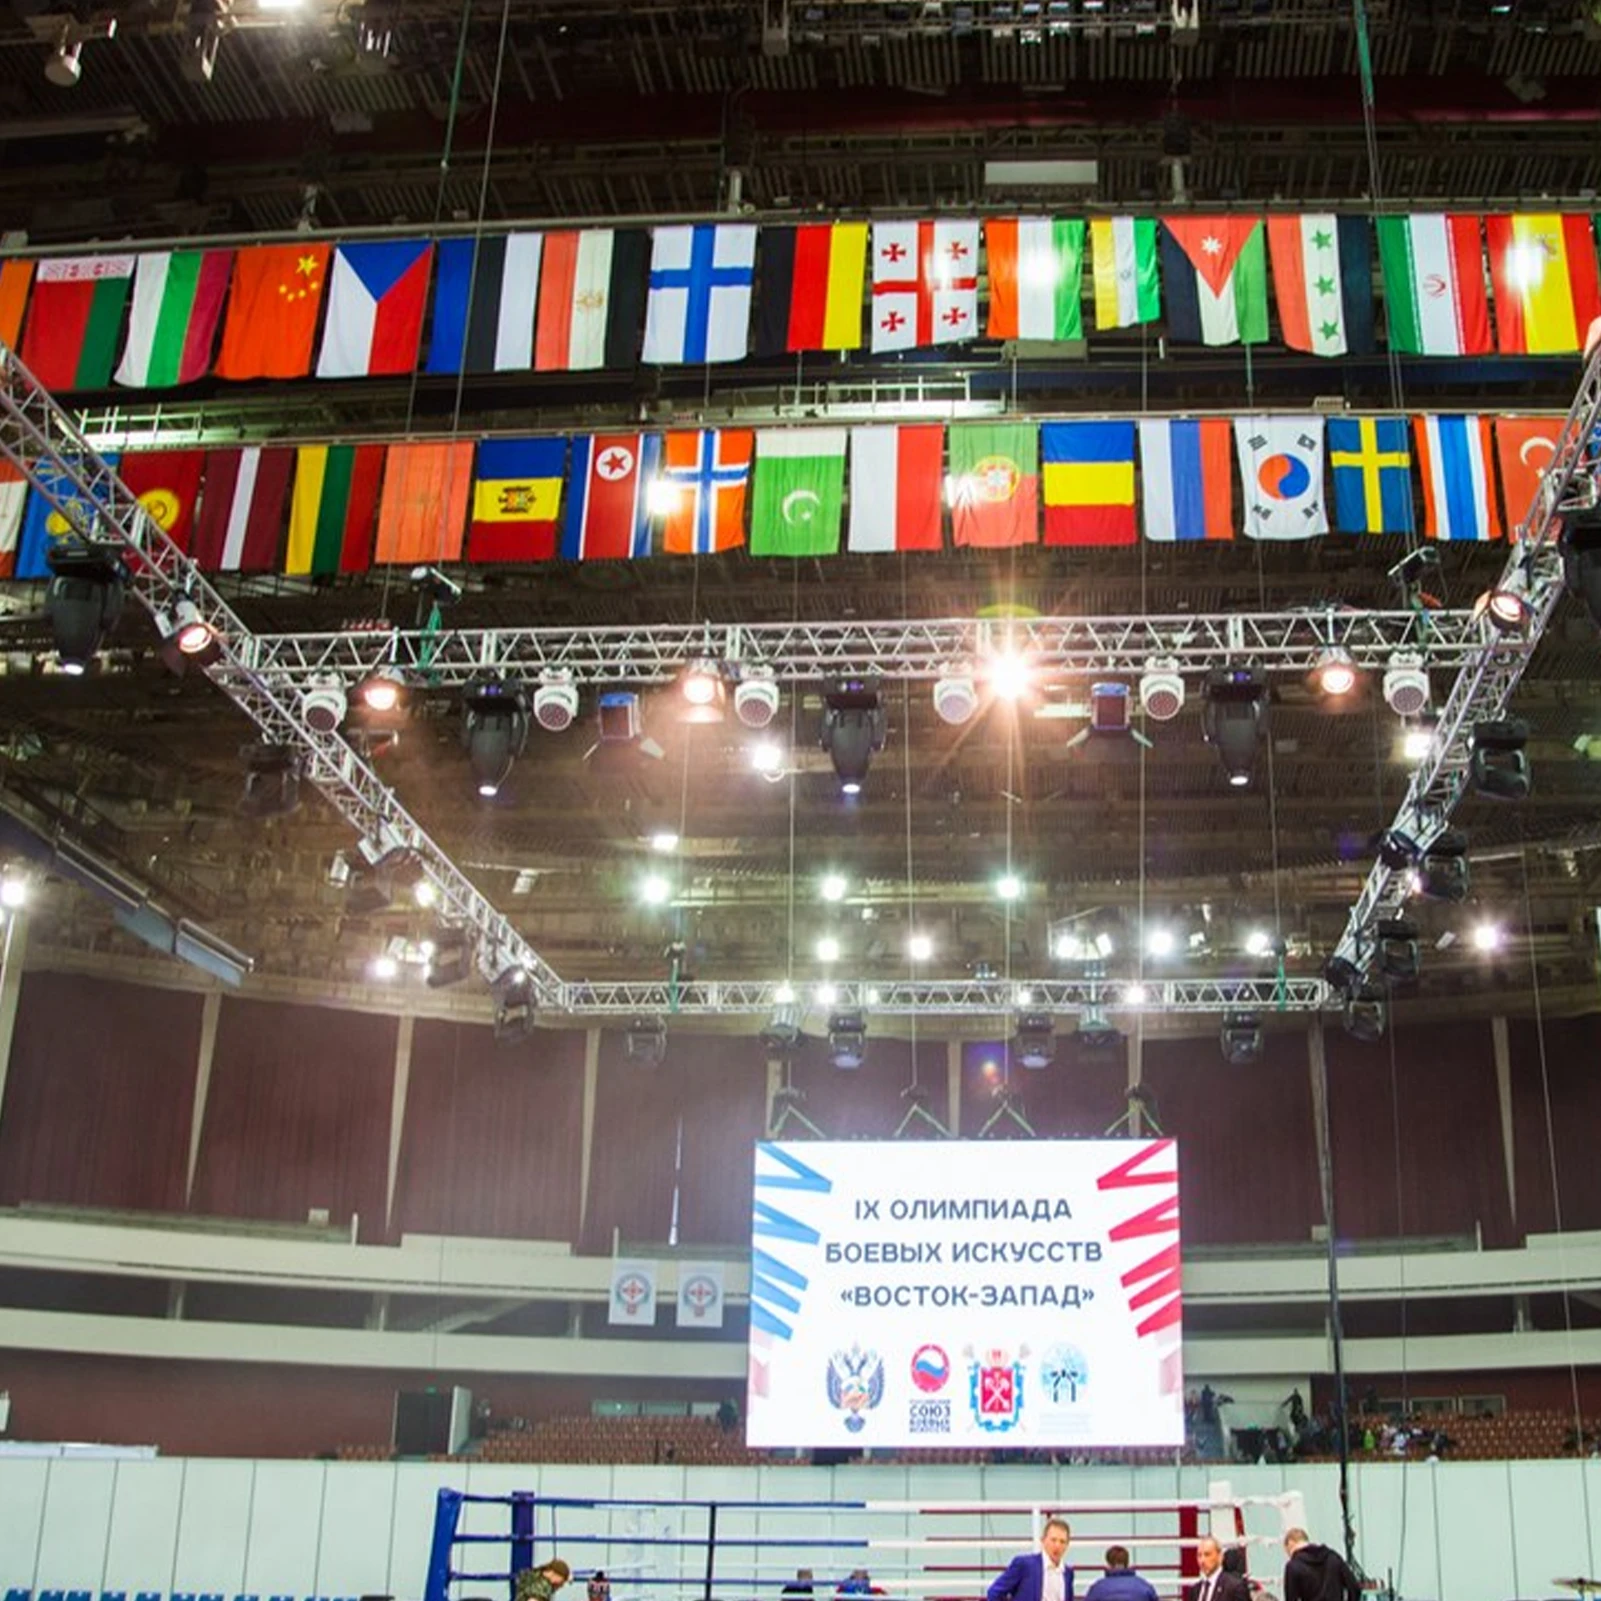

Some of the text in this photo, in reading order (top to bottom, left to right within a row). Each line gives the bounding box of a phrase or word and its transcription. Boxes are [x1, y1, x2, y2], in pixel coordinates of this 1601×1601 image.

[890, 1199, 1072, 1222] ОЛИМПИАДА
[825, 1242, 1103, 1264] БОЕВЫХ ИСКУССТВ
[840, 1285, 1095, 1309] «ВОСТОК-ЗАПАД»
[909, 1404, 951, 1418] СОЮЗ
